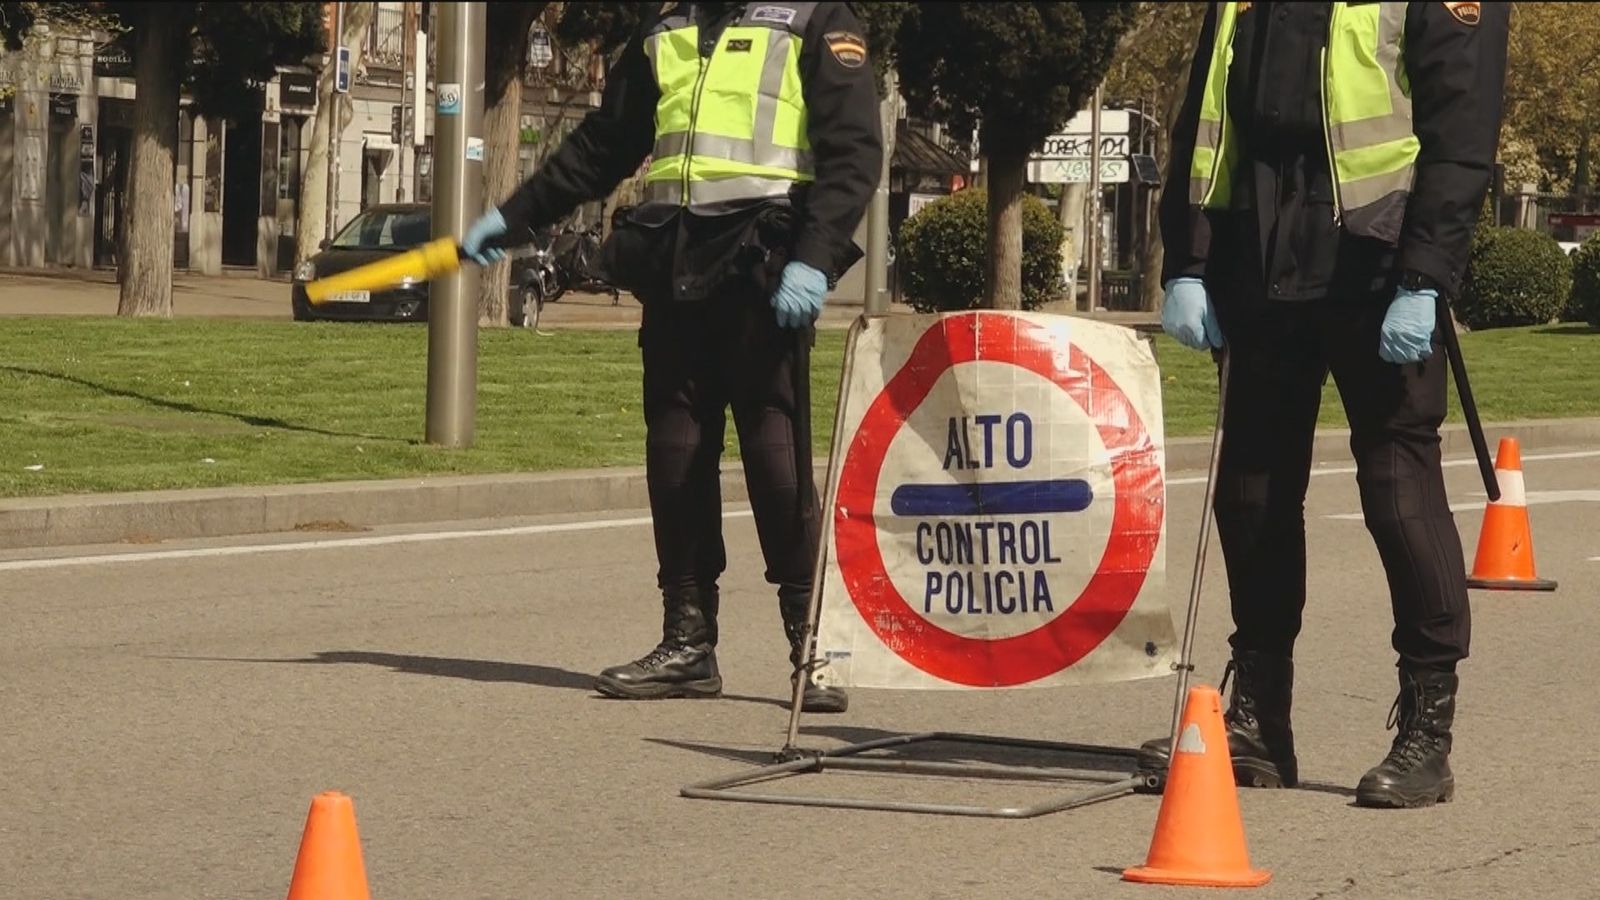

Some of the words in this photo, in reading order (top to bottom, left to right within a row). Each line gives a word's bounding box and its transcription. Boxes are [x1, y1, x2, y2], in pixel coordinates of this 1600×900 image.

[943, 412, 1032, 470] ALTO
[916, 520, 1061, 565] CONTROL
[924, 570, 1054, 614] POLICIA
